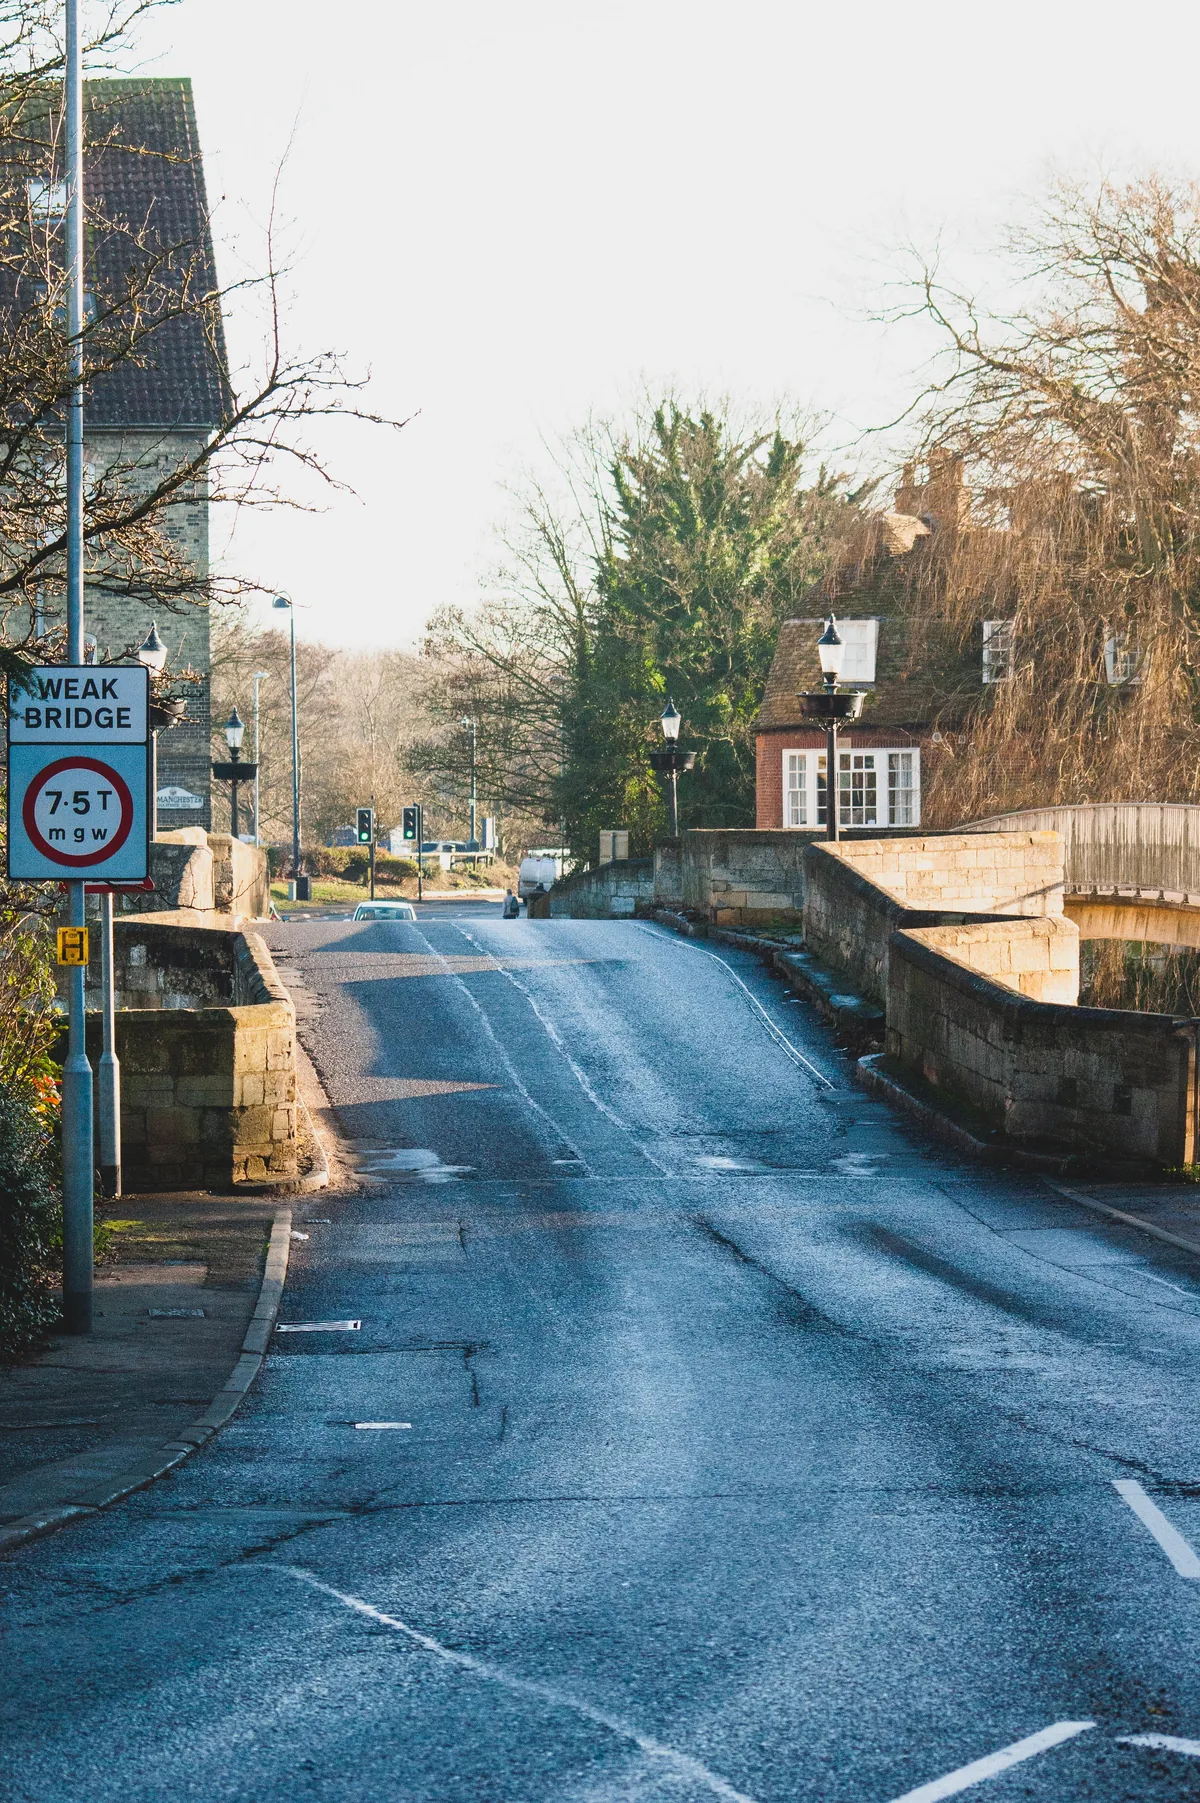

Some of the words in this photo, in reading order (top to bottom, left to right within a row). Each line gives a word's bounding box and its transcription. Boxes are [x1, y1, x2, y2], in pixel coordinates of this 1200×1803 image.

[38, 678, 119, 700] WEAK
[25, 707, 132, 729] BRIDGE
[62, 931, 84, 961] H
